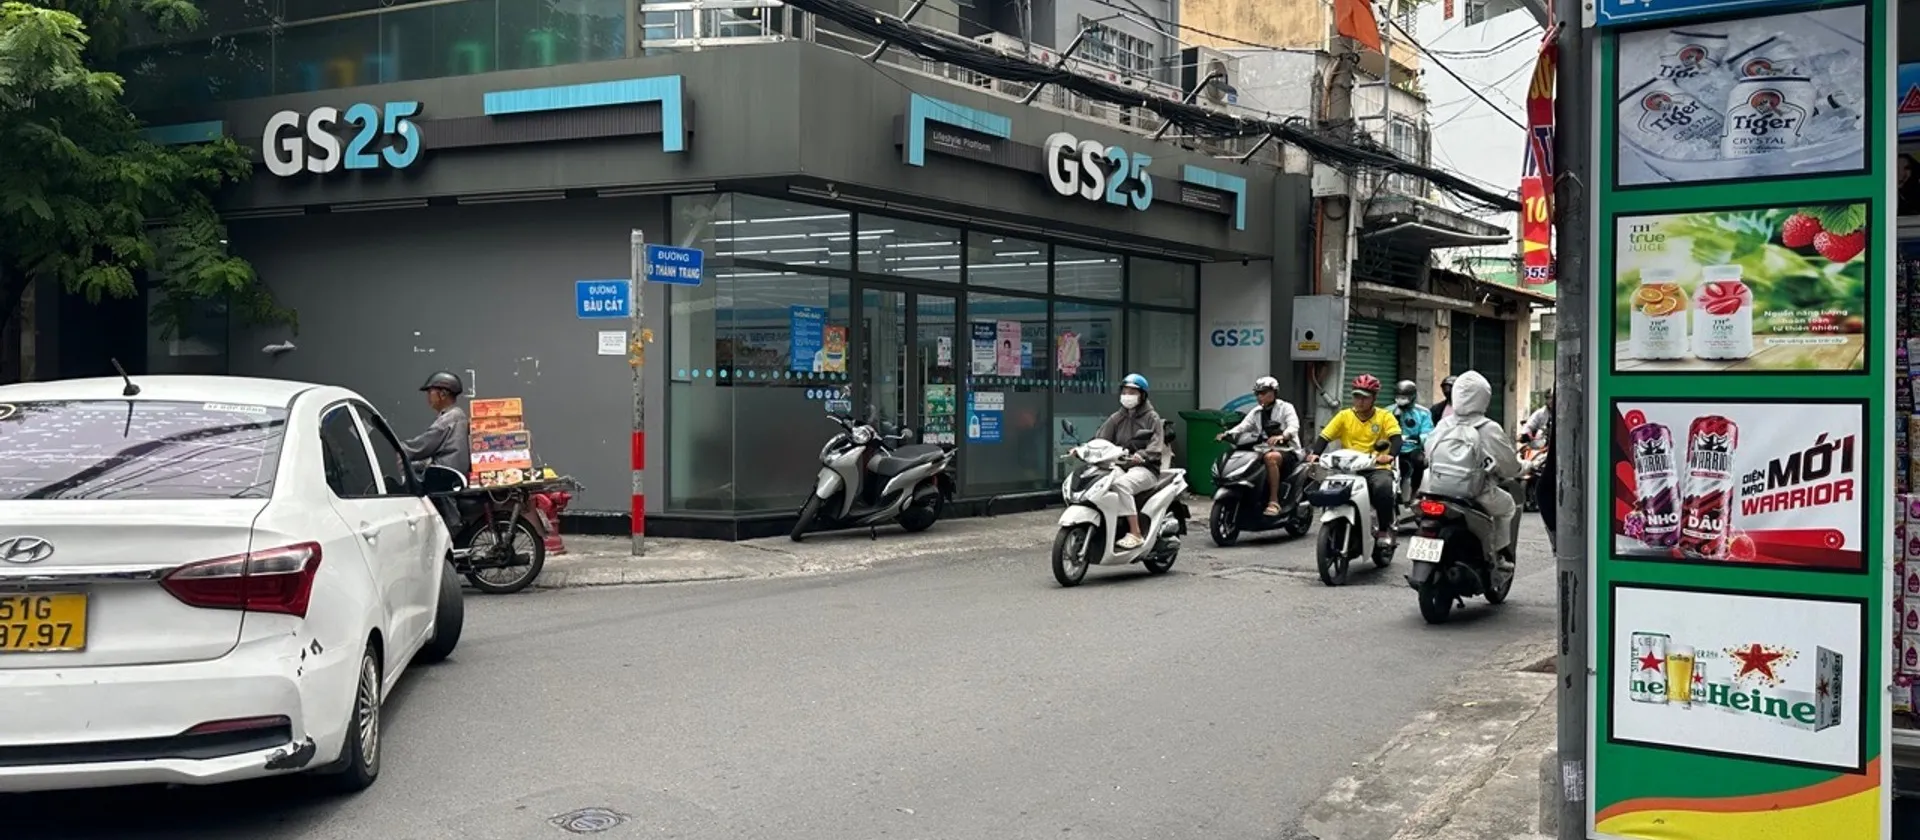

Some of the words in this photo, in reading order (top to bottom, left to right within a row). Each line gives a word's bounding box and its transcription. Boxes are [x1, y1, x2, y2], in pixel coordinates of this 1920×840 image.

[1650, 101, 1700, 131] Tiger
[1733, 112, 1796, 136] Tiger
[262, 101, 420, 177] GS25
[933, 131, 962, 147] Lifestyle
[963, 138, 992, 152] Platform
[1732, 136, 1786, 146] CRYSTAL
[1046, 132, 1153, 212] GS25
[1627, 243, 1665, 252] JUICE
[1629, 232, 1665, 244] true
[604, 296, 624, 311] CÁT
[1211, 328, 1265, 347] GS25
[1767, 432, 1855, 490] MỚI
[1742, 469, 1765, 485] DIỆN
[1741, 482, 1765, 497] MẠO
[1741, 478, 1854, 517] WARRIOR
[1647, 513, 1678, 525] NHO
[1688, 515, 1724, 530] DÂU
[0, 596, 51, 620] 51G
[1707, 682, 1816, 725] Heine
